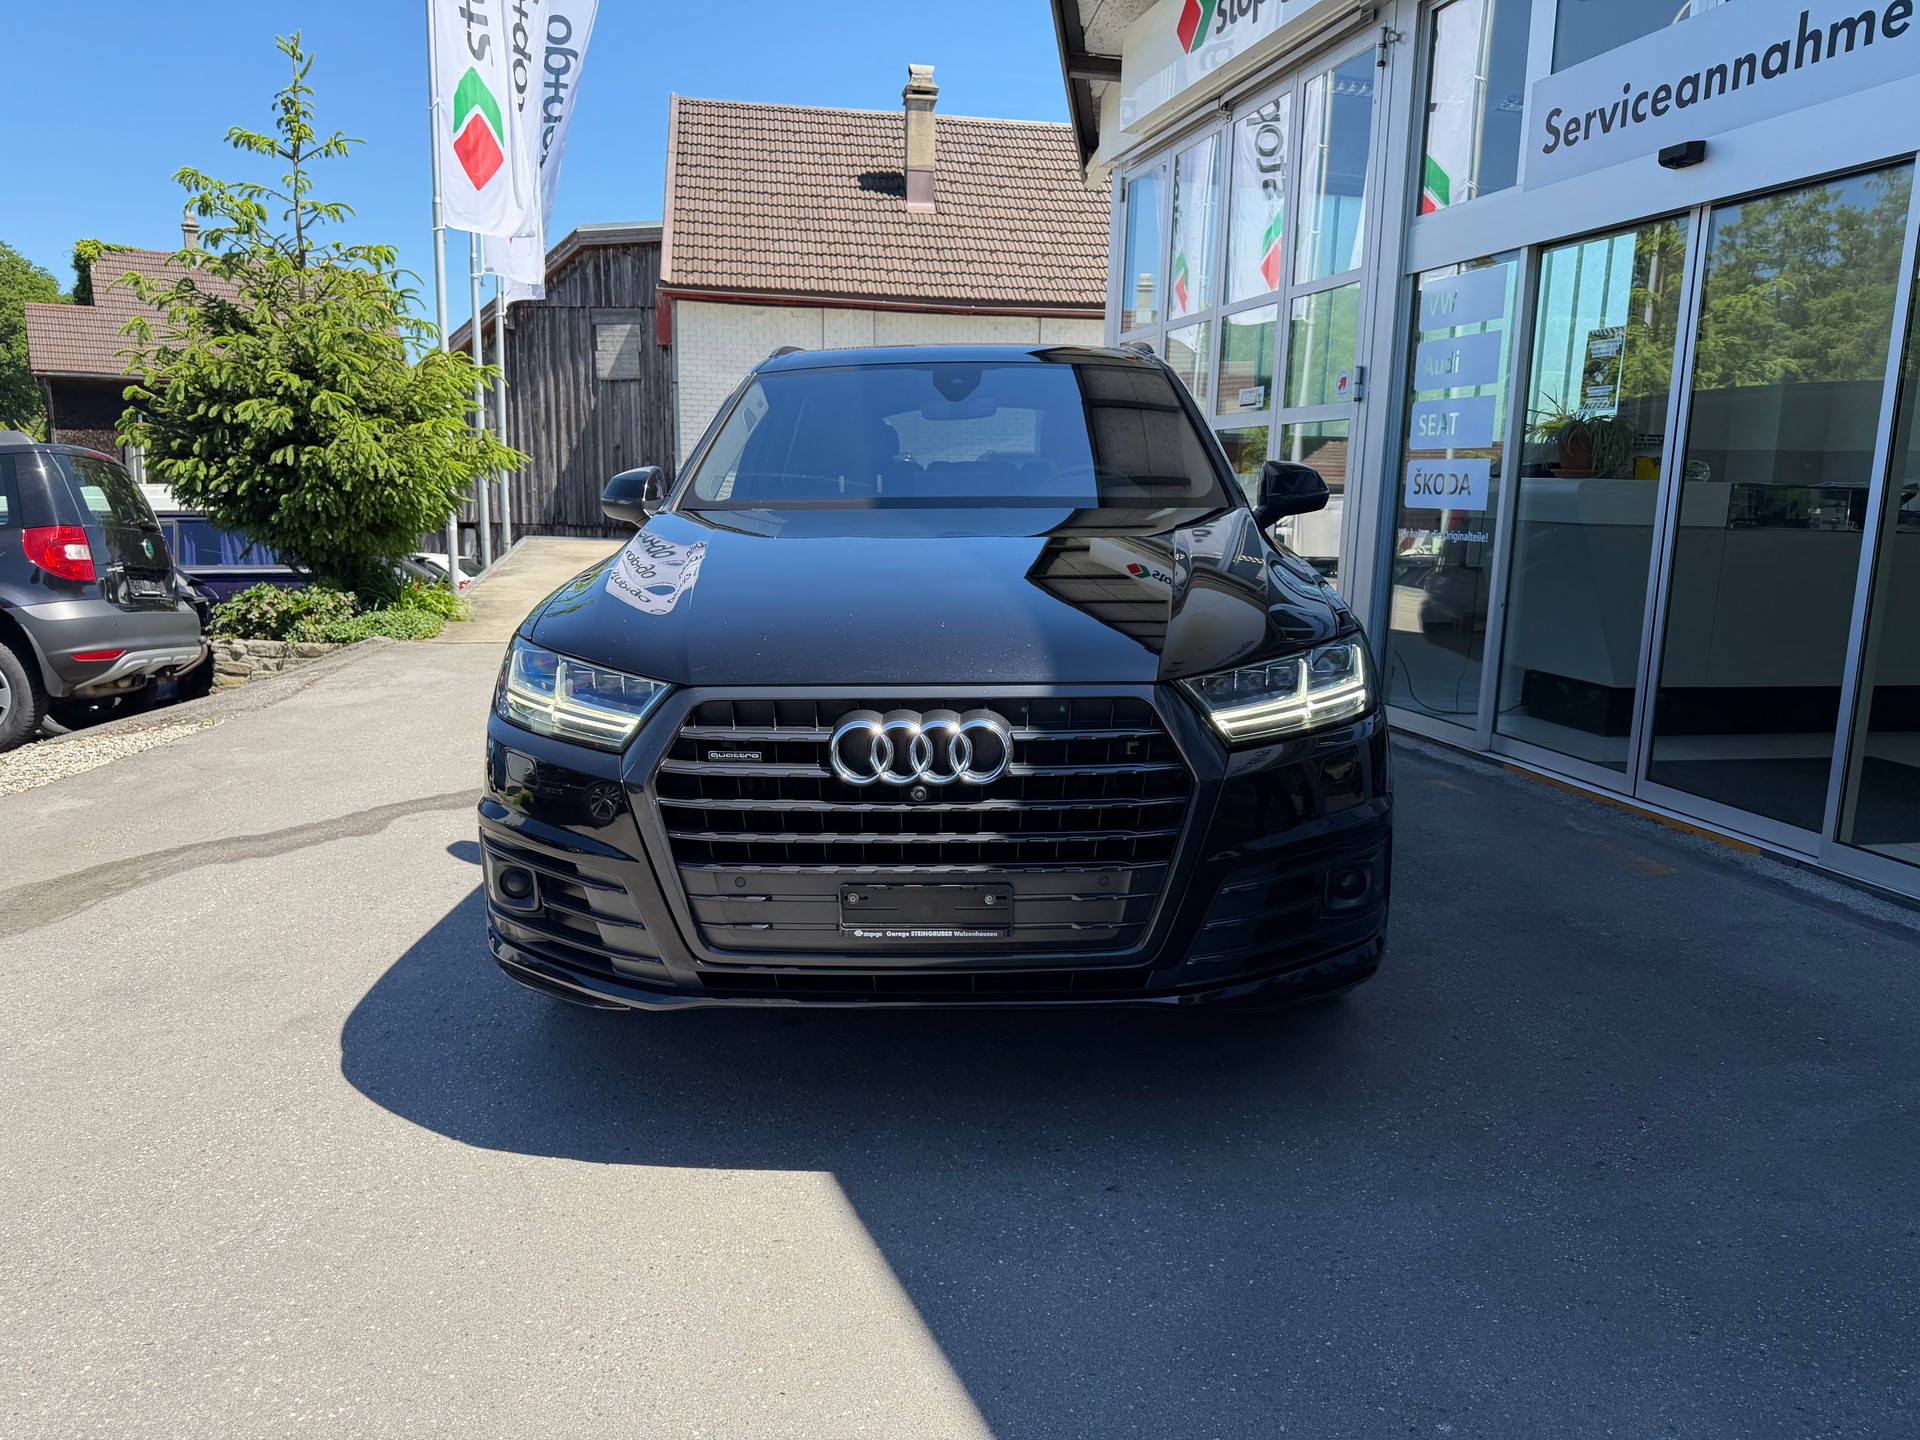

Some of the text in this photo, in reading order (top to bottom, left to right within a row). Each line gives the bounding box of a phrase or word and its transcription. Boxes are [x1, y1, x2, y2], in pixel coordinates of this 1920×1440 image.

[1542, 0, 1913, 154] Serviceannahme
[1429, 289, 1459, 316] VW
[1423, 350, 1460, 376] Audi
[1417, 412, 1460, 437] SEAT
[1413, 467, 1472, 496] ŠKODA
[1443, 530, 1489, 543] Originalteile!
[886, 930, 910, 938] Garage
